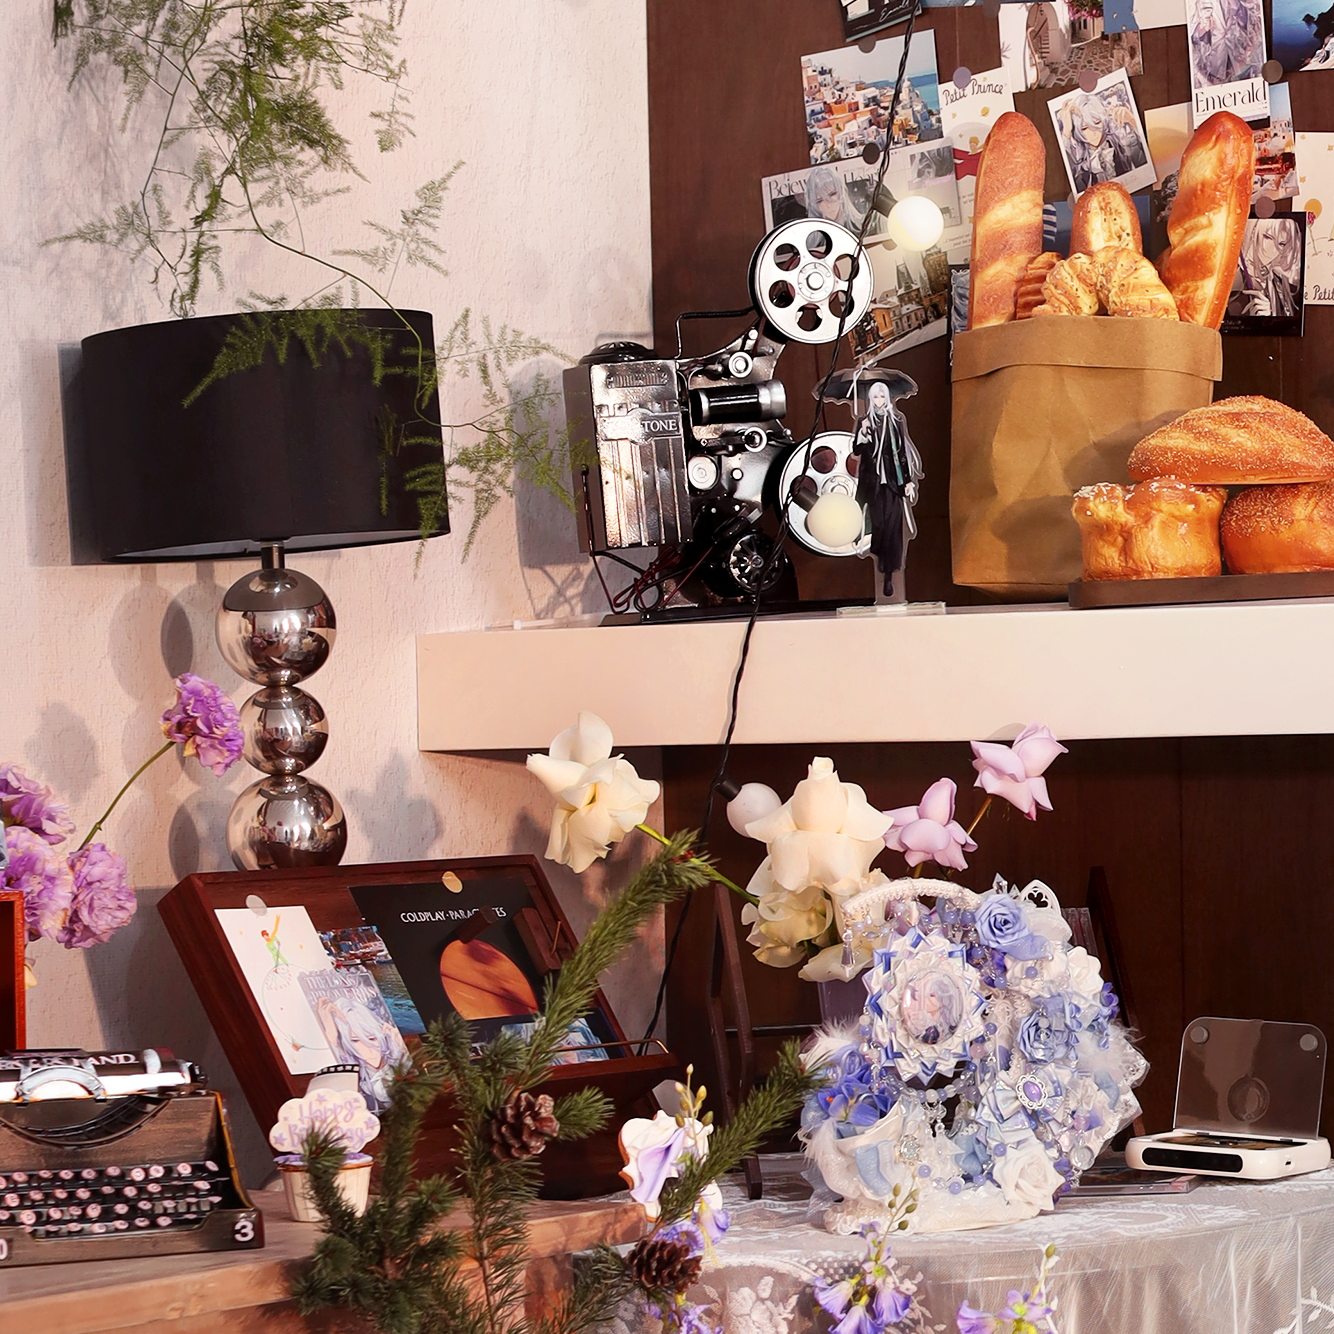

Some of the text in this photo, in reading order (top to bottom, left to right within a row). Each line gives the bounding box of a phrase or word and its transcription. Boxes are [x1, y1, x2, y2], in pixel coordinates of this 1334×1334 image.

[942, 78, 1004, 106] Petit Prince
[1195, 80, 1267, 113] Emerald
[299, 1100, 362, 1124] Happy
[234, 1219, 255, 1242] 3
